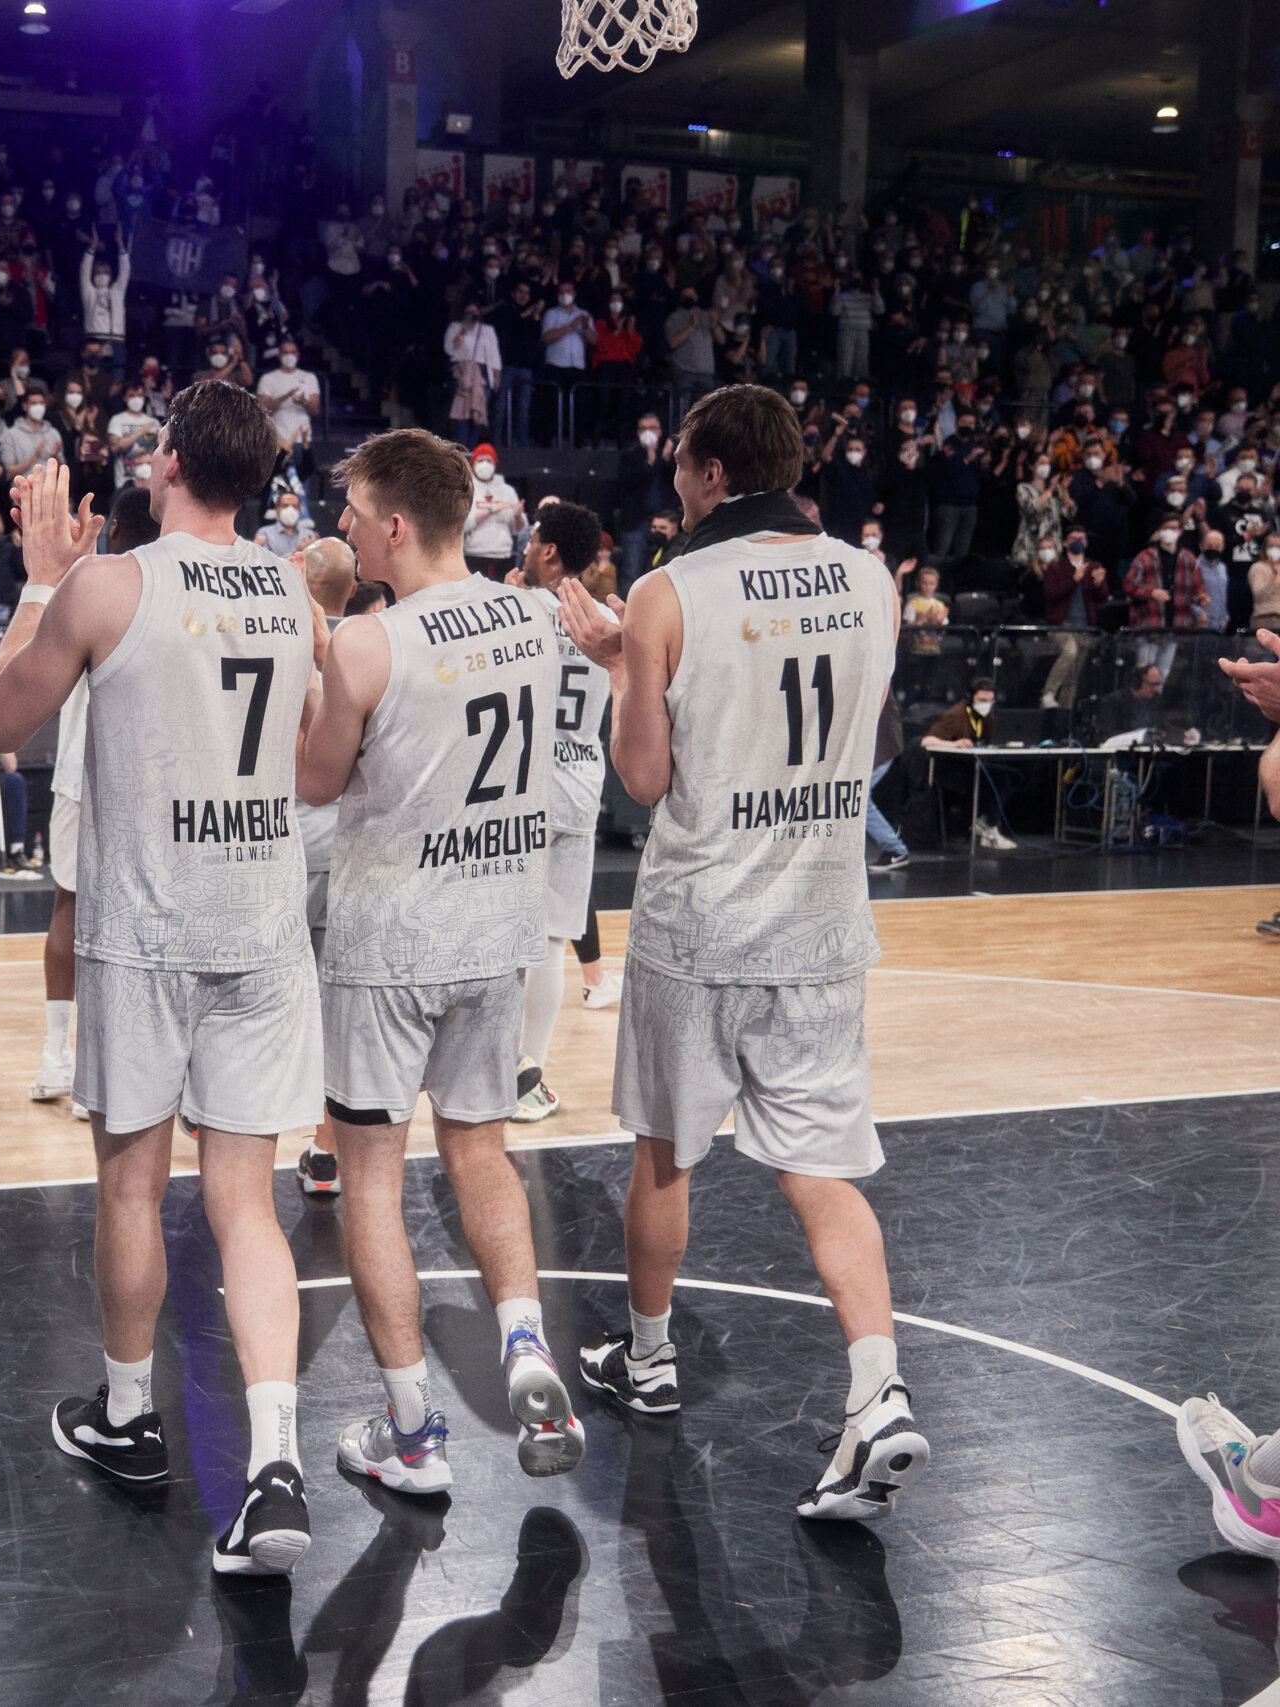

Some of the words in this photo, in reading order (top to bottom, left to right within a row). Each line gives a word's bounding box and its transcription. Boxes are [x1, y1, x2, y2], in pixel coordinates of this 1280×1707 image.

[395, 52, 410, 74] B
[179, 561, 287, 599] MEISNER
[739, 563, 851, 600] KOTSAR
[245, 617, 298, 635] BLACK
[419, 595, 532, 645] HOLLATZ
[769, 618, 793, 637] 28
[800, 611, 864, 634] BLACK
[465, 652, 487, 673] 28
[492, 638, 544, 666] BLACK
[221, 657, 274, 776] 7
[556, 665, 589, 731] 5
[779, 654, 834, 766] 11
[465, 684, 534, 808] 21
[732, 779, 863, 829] HAMBURG
[461, 858, 524, 878] TOWERS
